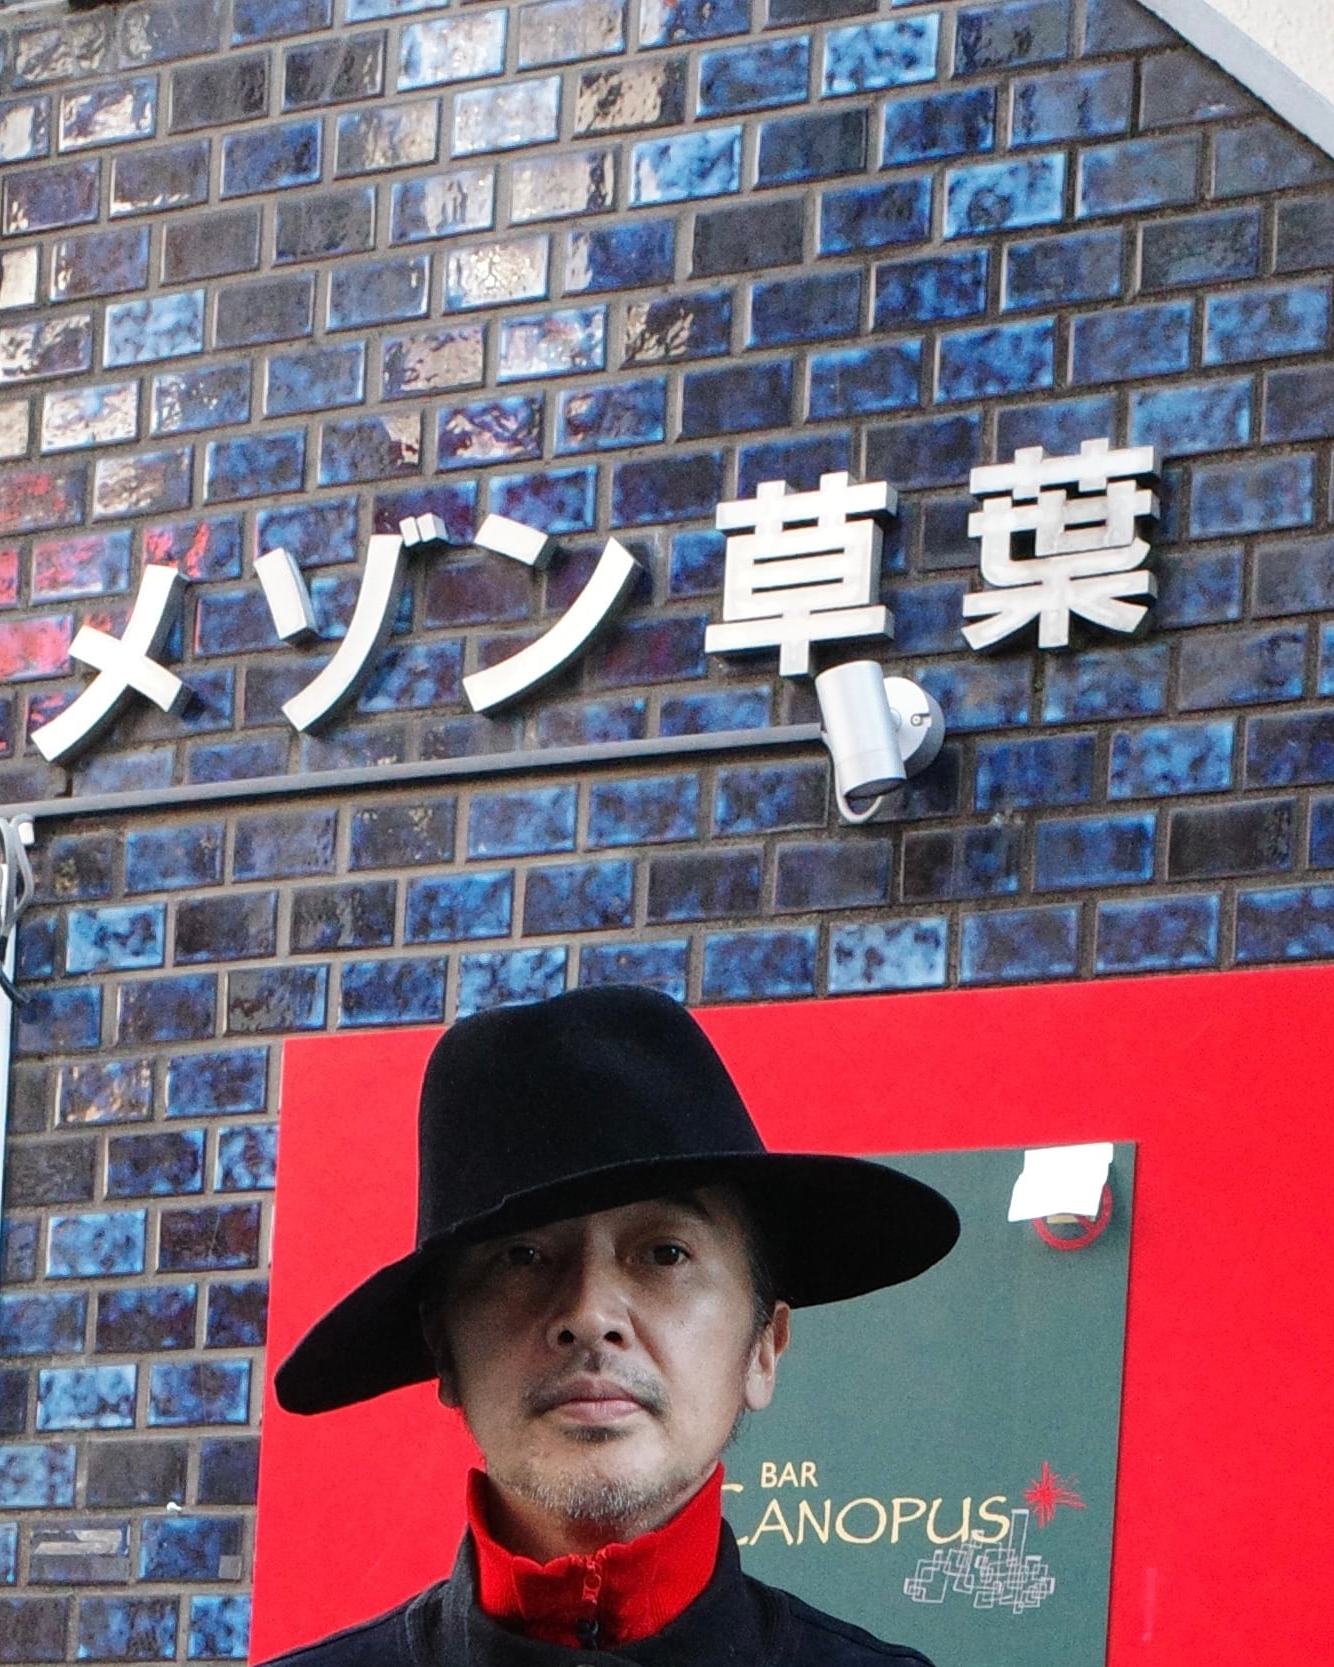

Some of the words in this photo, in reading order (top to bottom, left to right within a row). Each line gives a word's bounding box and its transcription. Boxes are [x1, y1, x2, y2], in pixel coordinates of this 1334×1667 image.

[32, 438, 1161, 762] メゾン草葉
[761, 1462, 819, 1488] BAR
